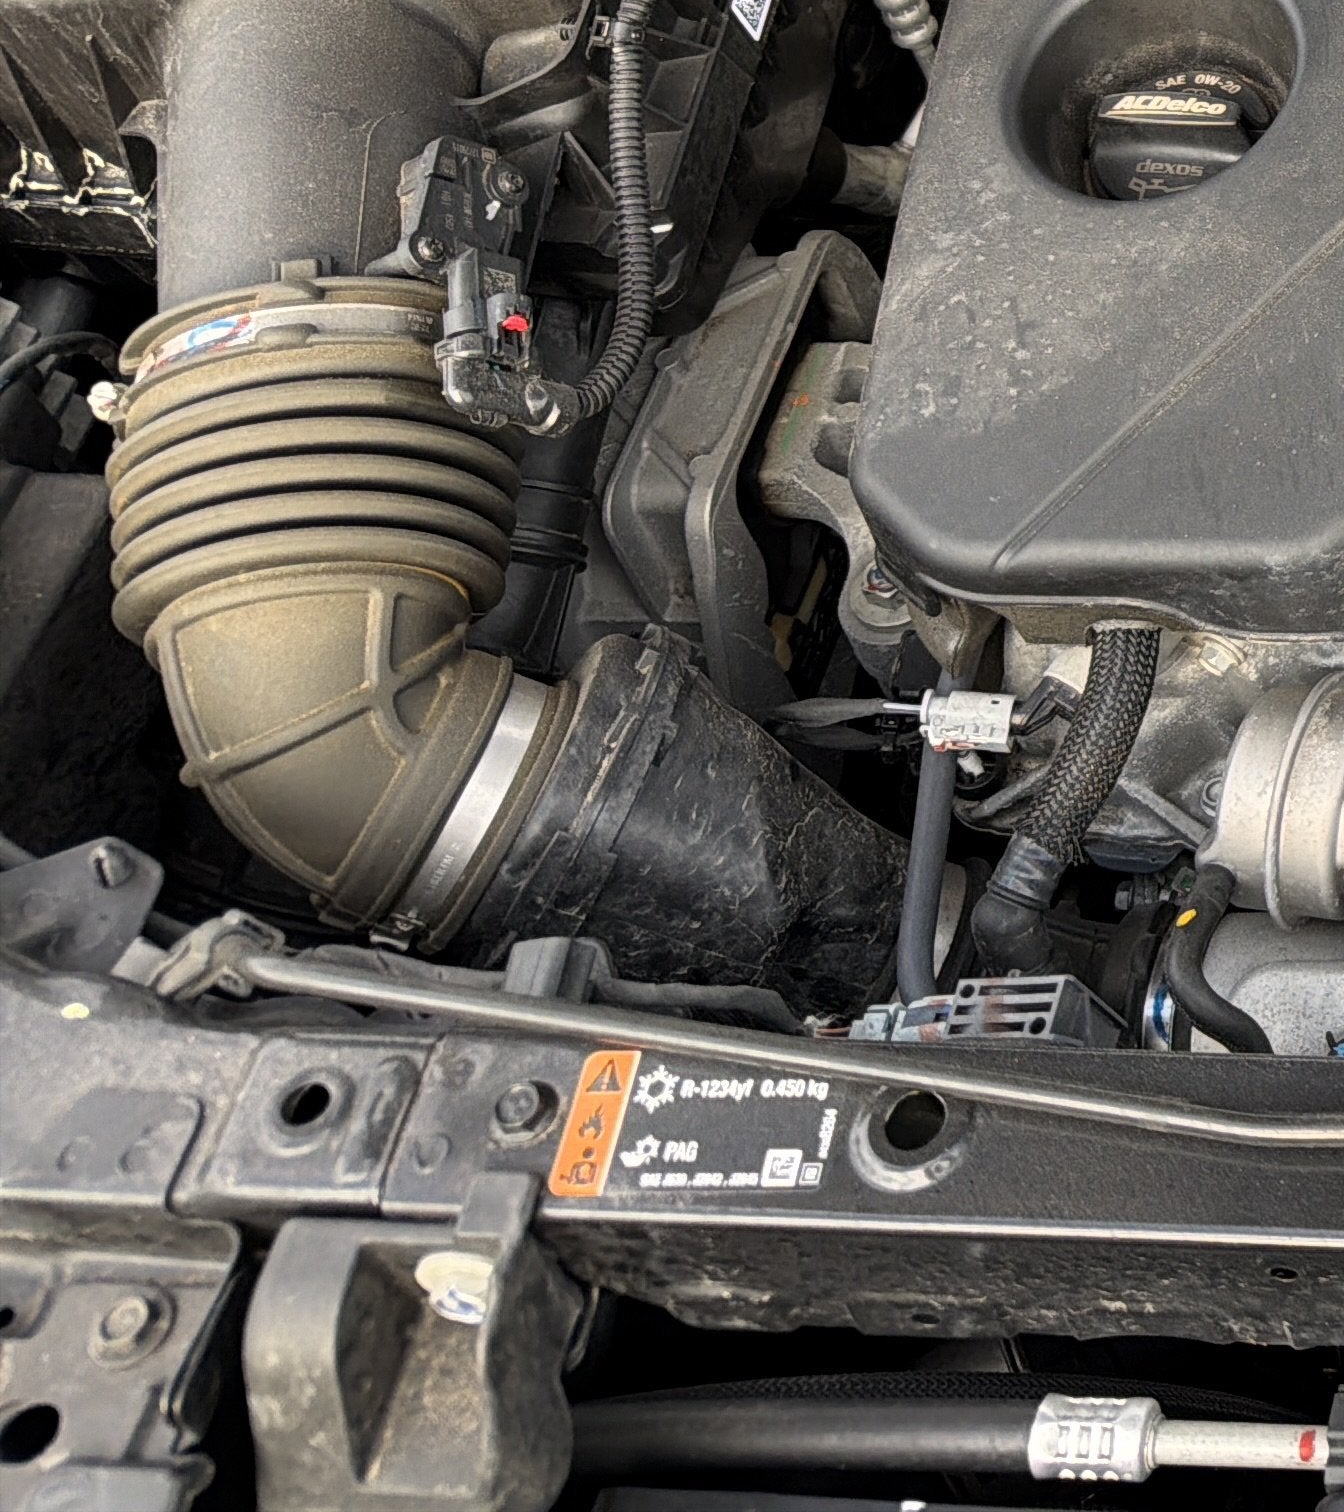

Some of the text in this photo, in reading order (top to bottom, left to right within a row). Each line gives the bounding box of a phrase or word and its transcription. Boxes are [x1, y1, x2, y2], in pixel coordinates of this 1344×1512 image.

[1155, 73, 1242, 94] SAE 0W-20
[1115, 95, 1227, 115] ACDelco
[1135, 158, 1205, 177] dexos
[680, 1078, 829, 1102] R-1234yf 0.450 kg
[662, 1140, 698, 1162] PAG
